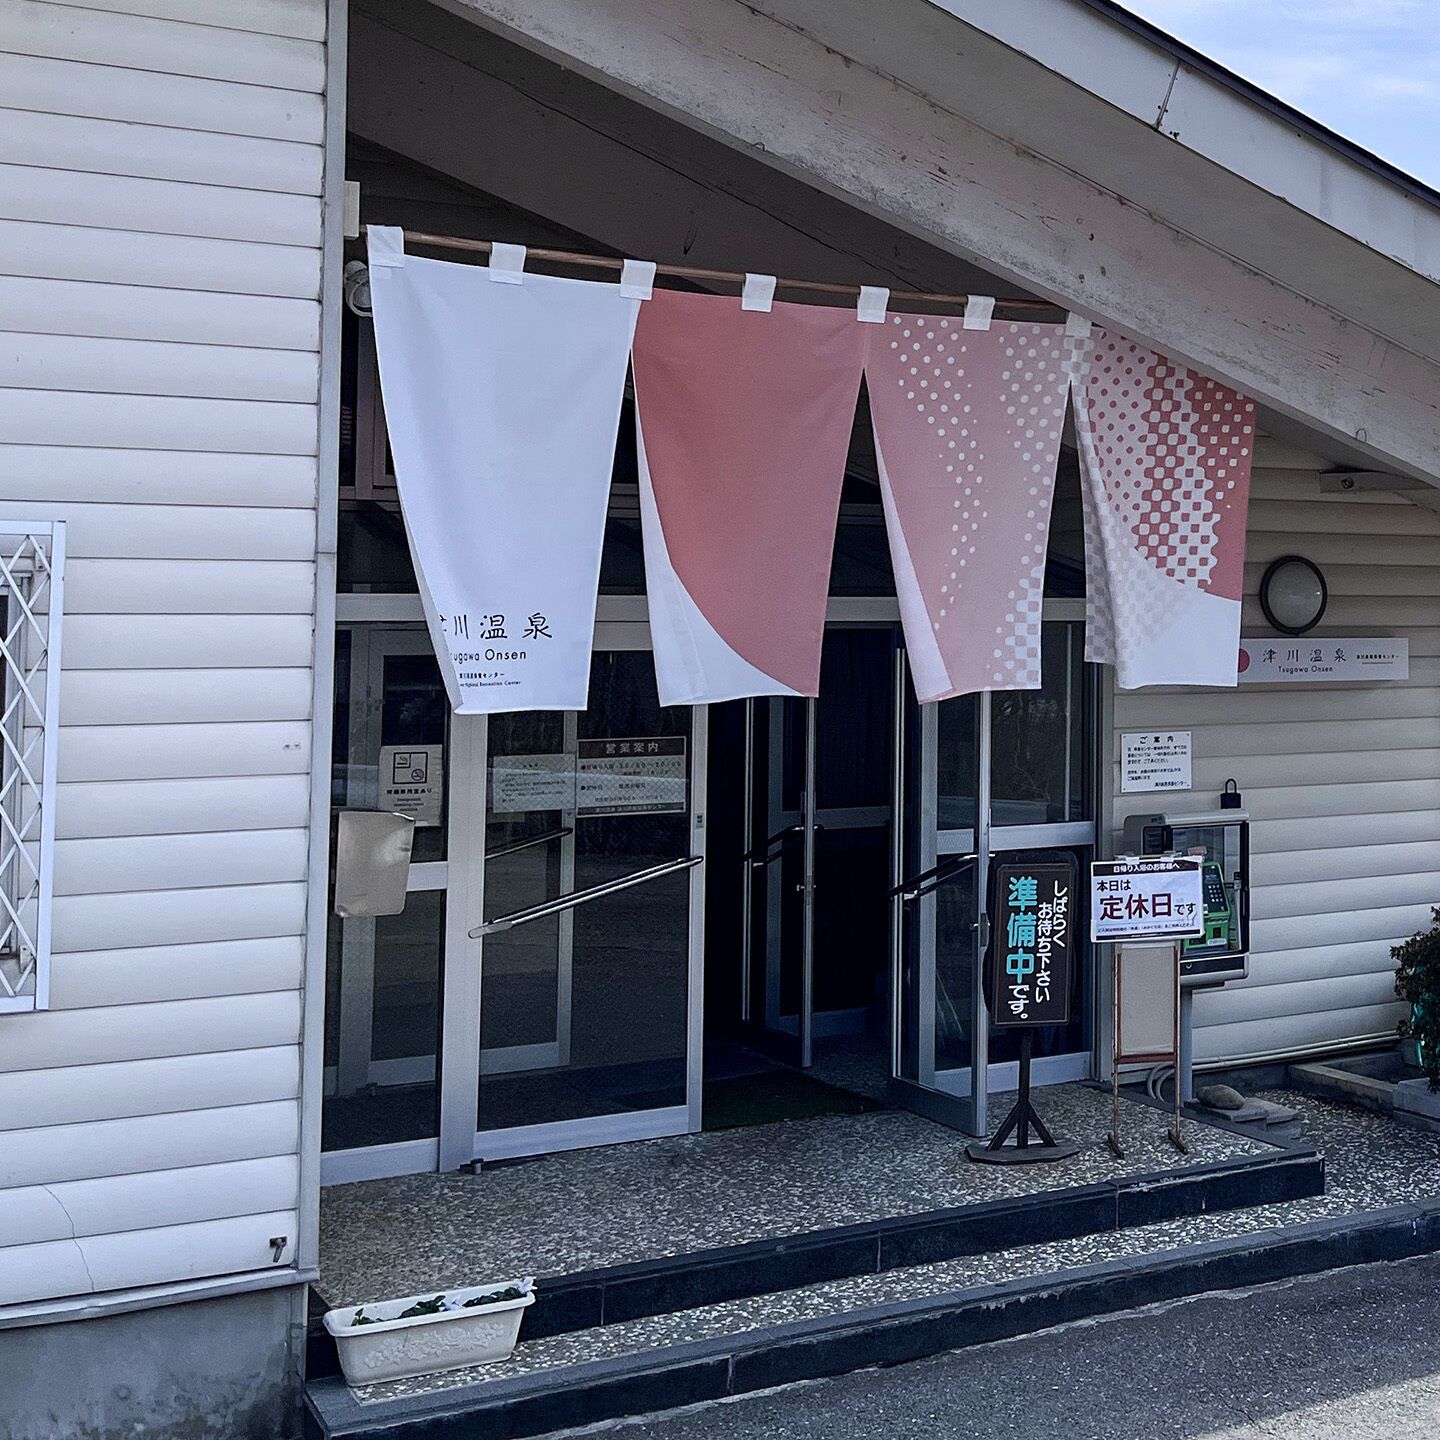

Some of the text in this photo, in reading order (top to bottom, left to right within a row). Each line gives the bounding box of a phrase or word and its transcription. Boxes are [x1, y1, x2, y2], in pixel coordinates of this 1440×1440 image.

[450, 648, 527, 664] ugawa Onsen
[1262, 647, 1347, 664] 津川温泉
[1278, 664, 1334, 675] Tsugawa Onsen
[605, 741, 660, 755] 営業案内
[1096, 879, 1132, 893] 本日は
[1053, 879, 1069, 948] しばらく
[1099, 892, 1197, 921] 定休日です
[1006, 875, 1038, 1020] 準備中です。
[1035, 901, 1053, 1004] お待ち下さい
